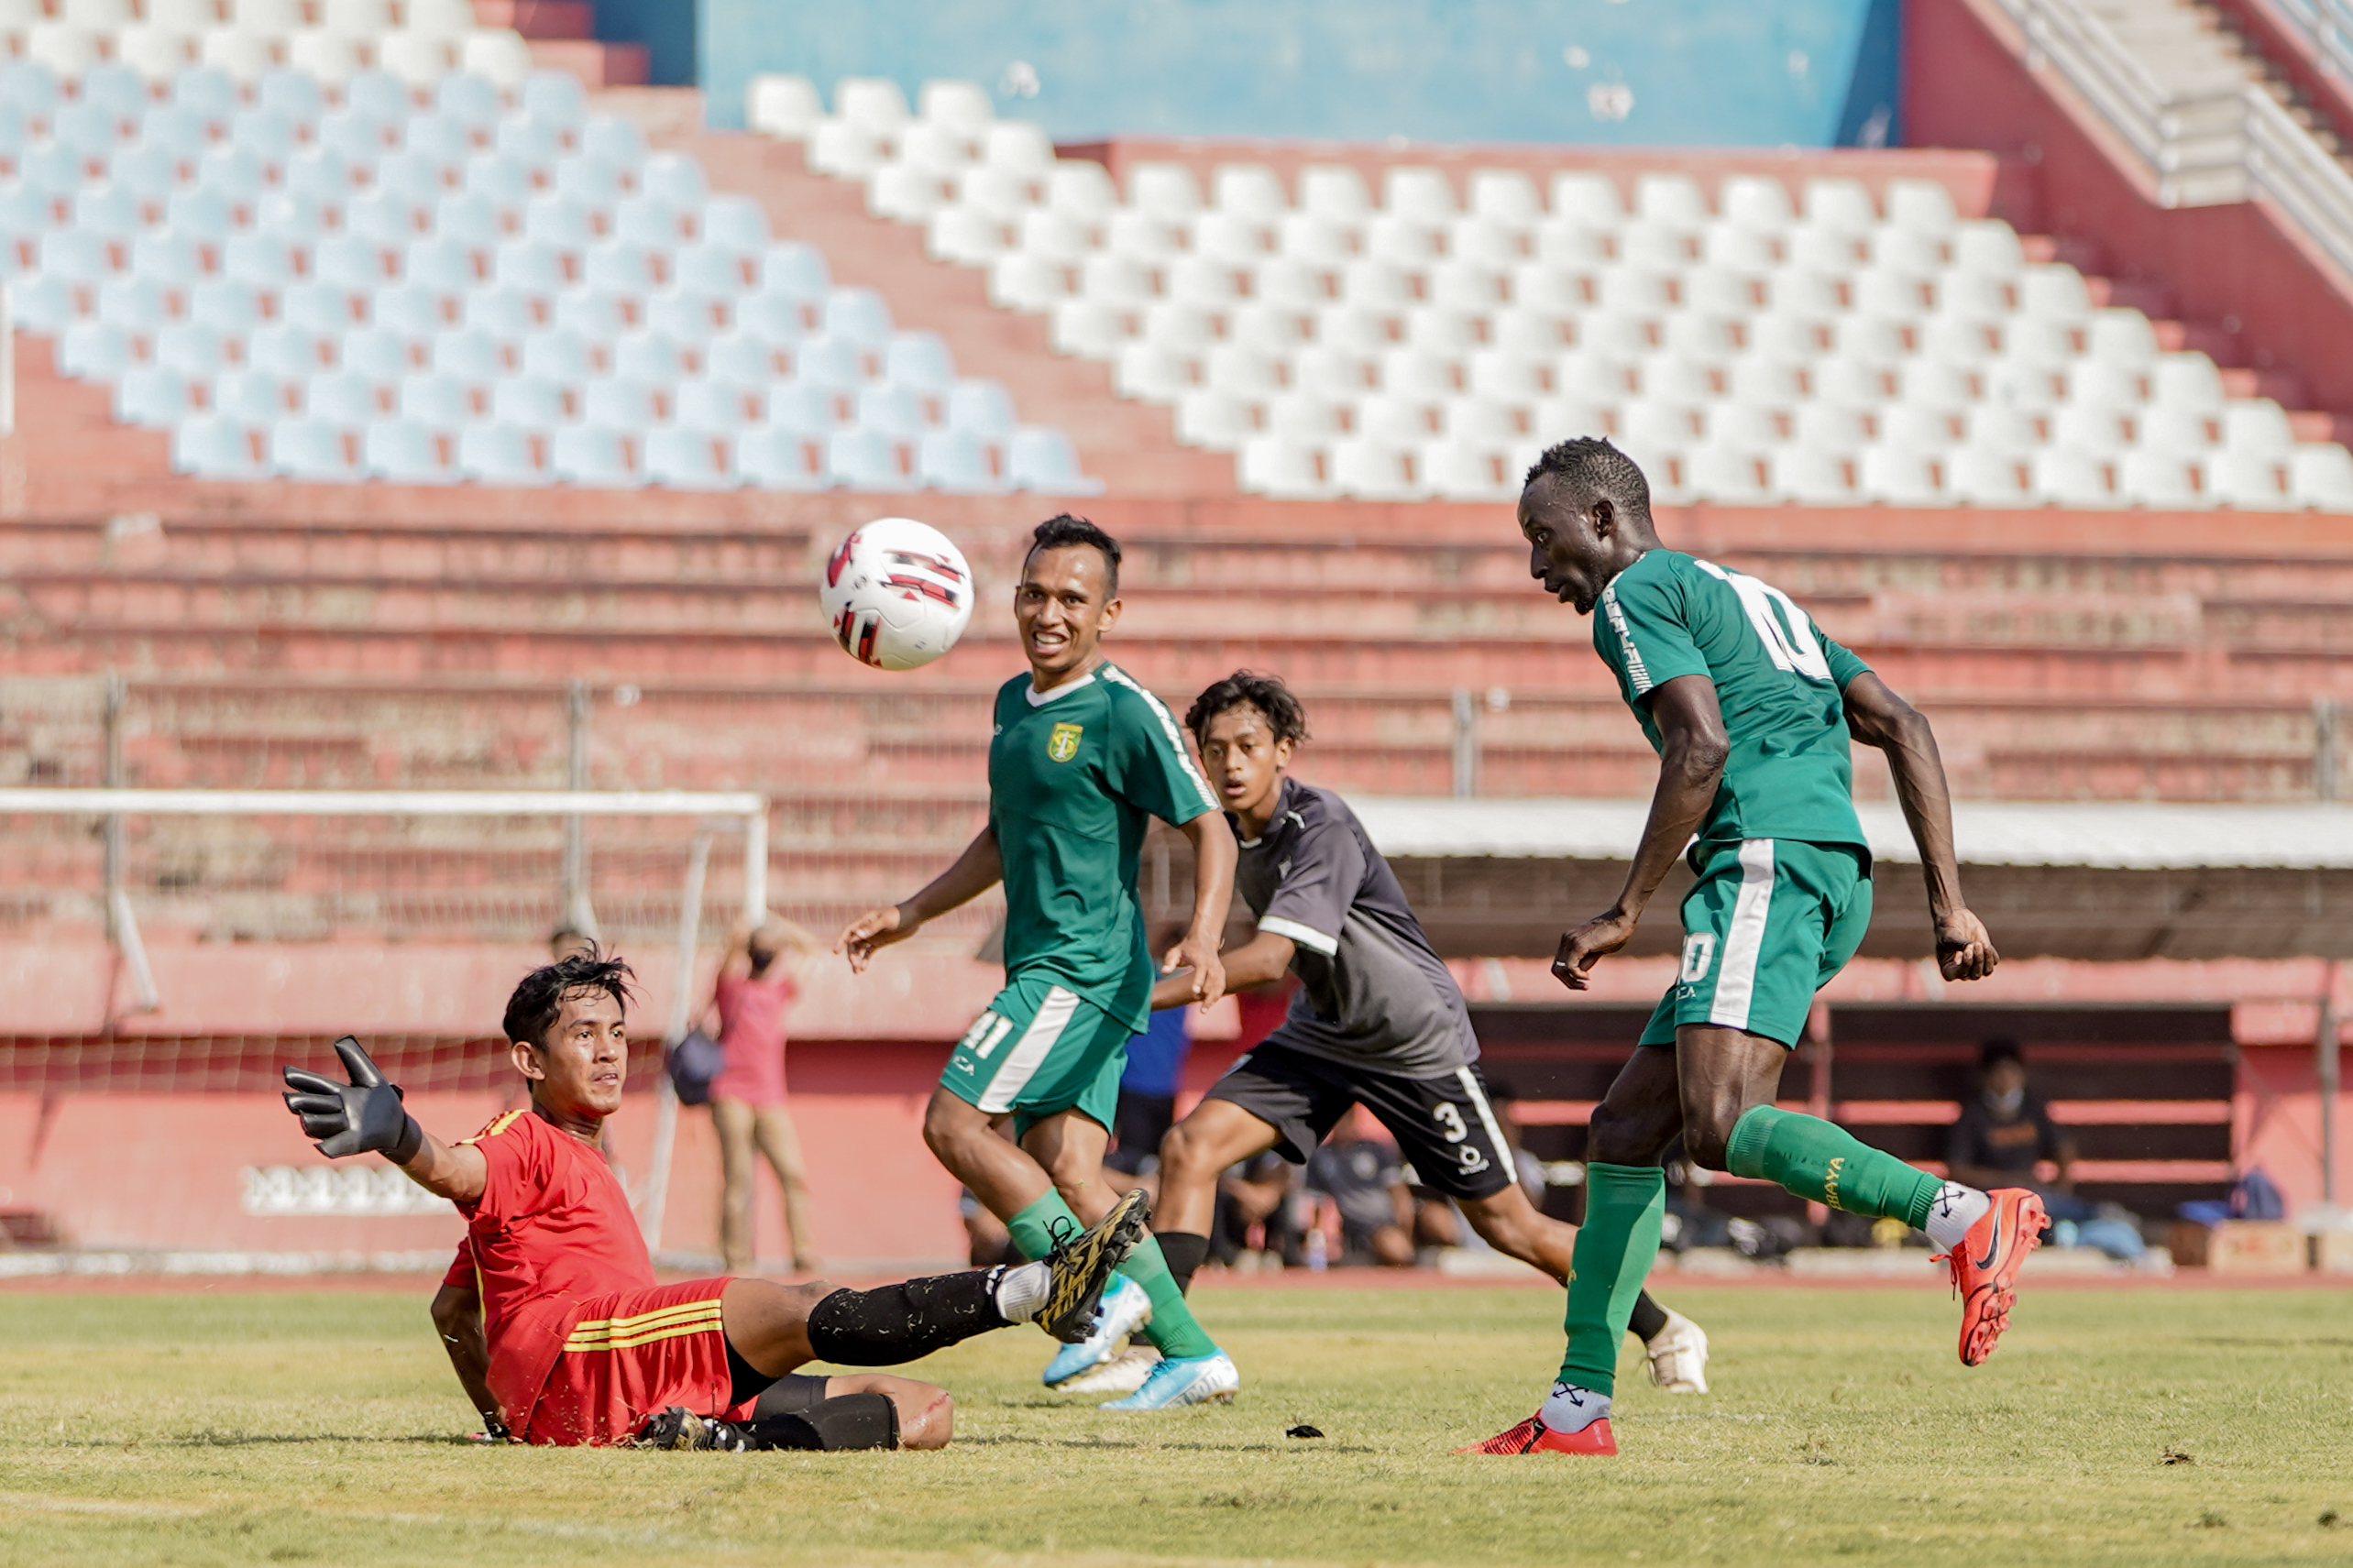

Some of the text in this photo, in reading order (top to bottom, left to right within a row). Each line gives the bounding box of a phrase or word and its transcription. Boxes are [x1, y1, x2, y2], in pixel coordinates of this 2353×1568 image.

[1694, 559, 1833, 680] 10
[1676, 931, 1717, 986] 0
[1433, 1102, 1468, 1143] 3
